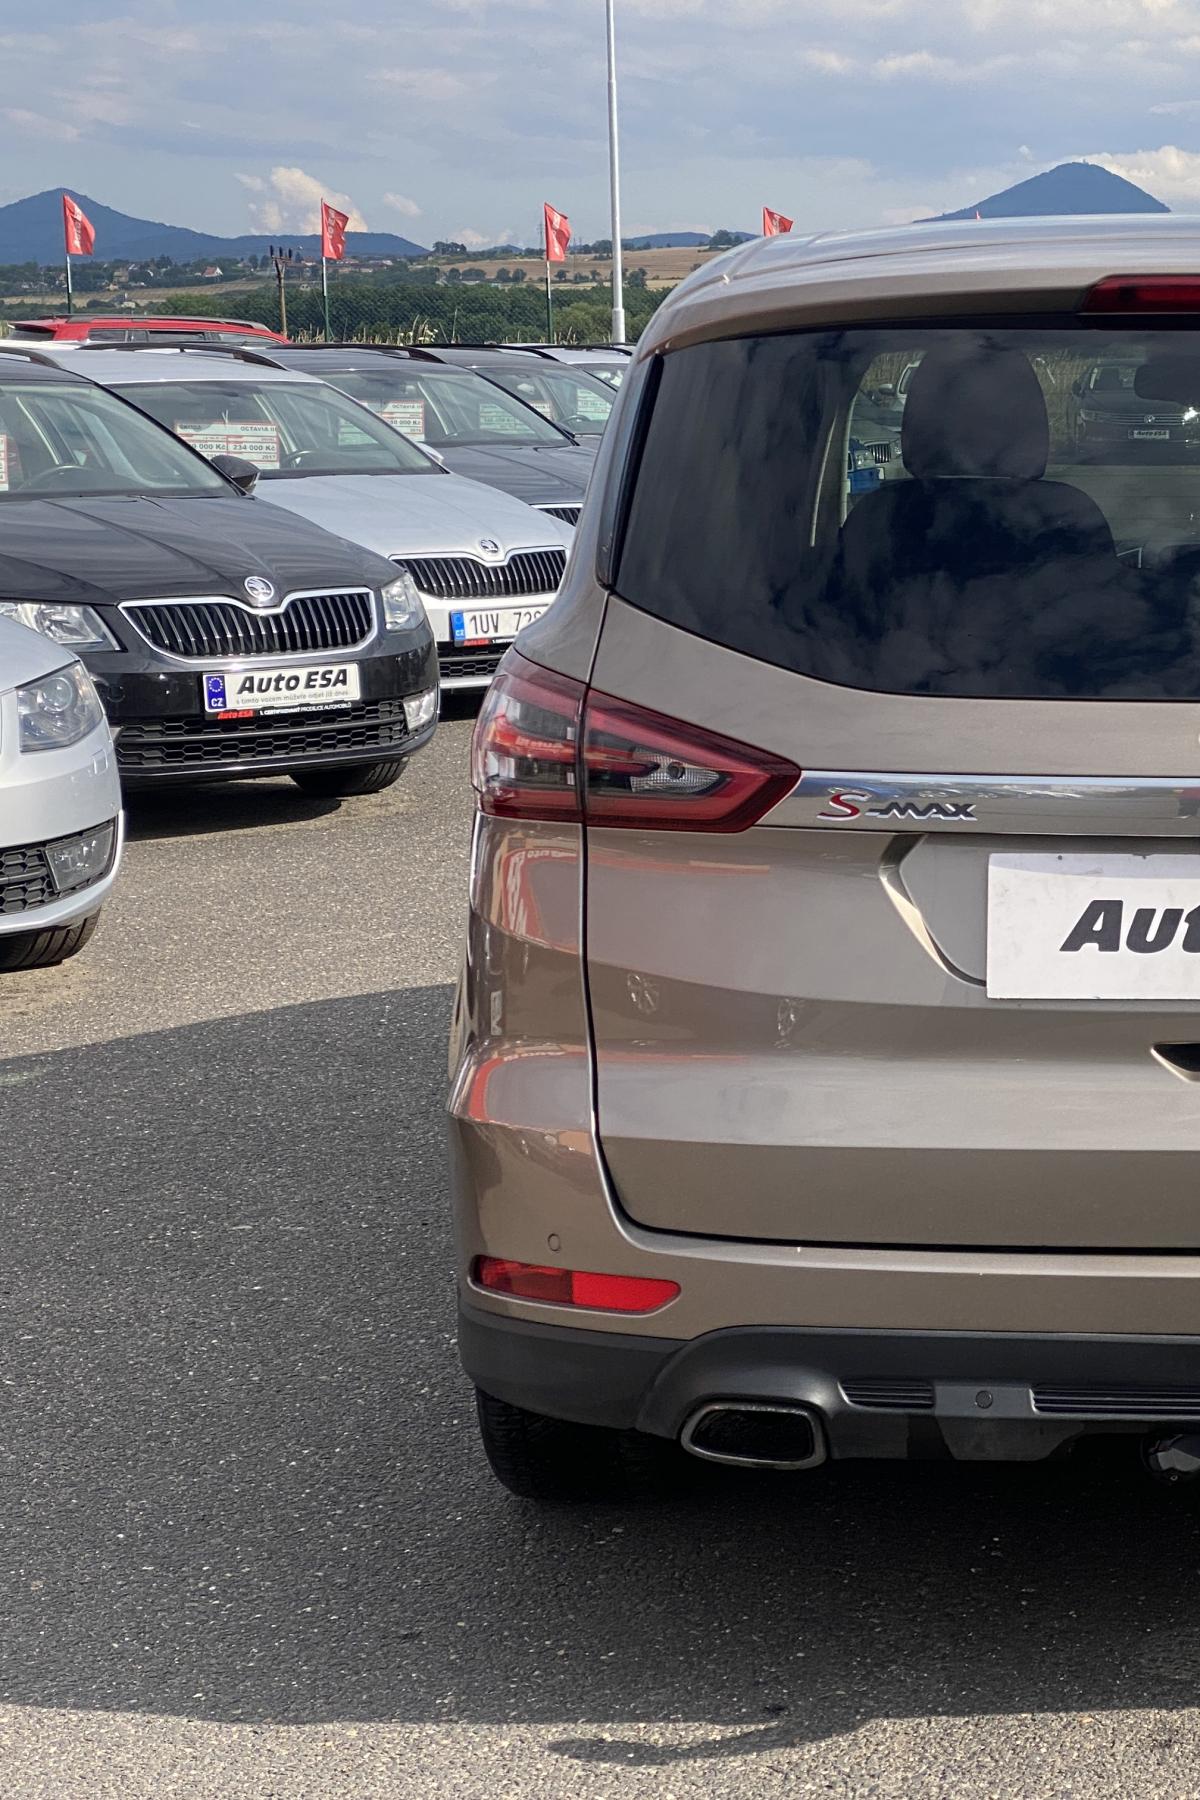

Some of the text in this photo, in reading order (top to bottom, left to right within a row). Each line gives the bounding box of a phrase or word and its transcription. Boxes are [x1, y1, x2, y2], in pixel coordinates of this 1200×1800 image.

[470, 612, 500, 635] 1UV
[236, 668, 349, 695] Auto ESA
[211, 697, 224, 708] CZ
[816, 792, 978, 822] S-MAX
